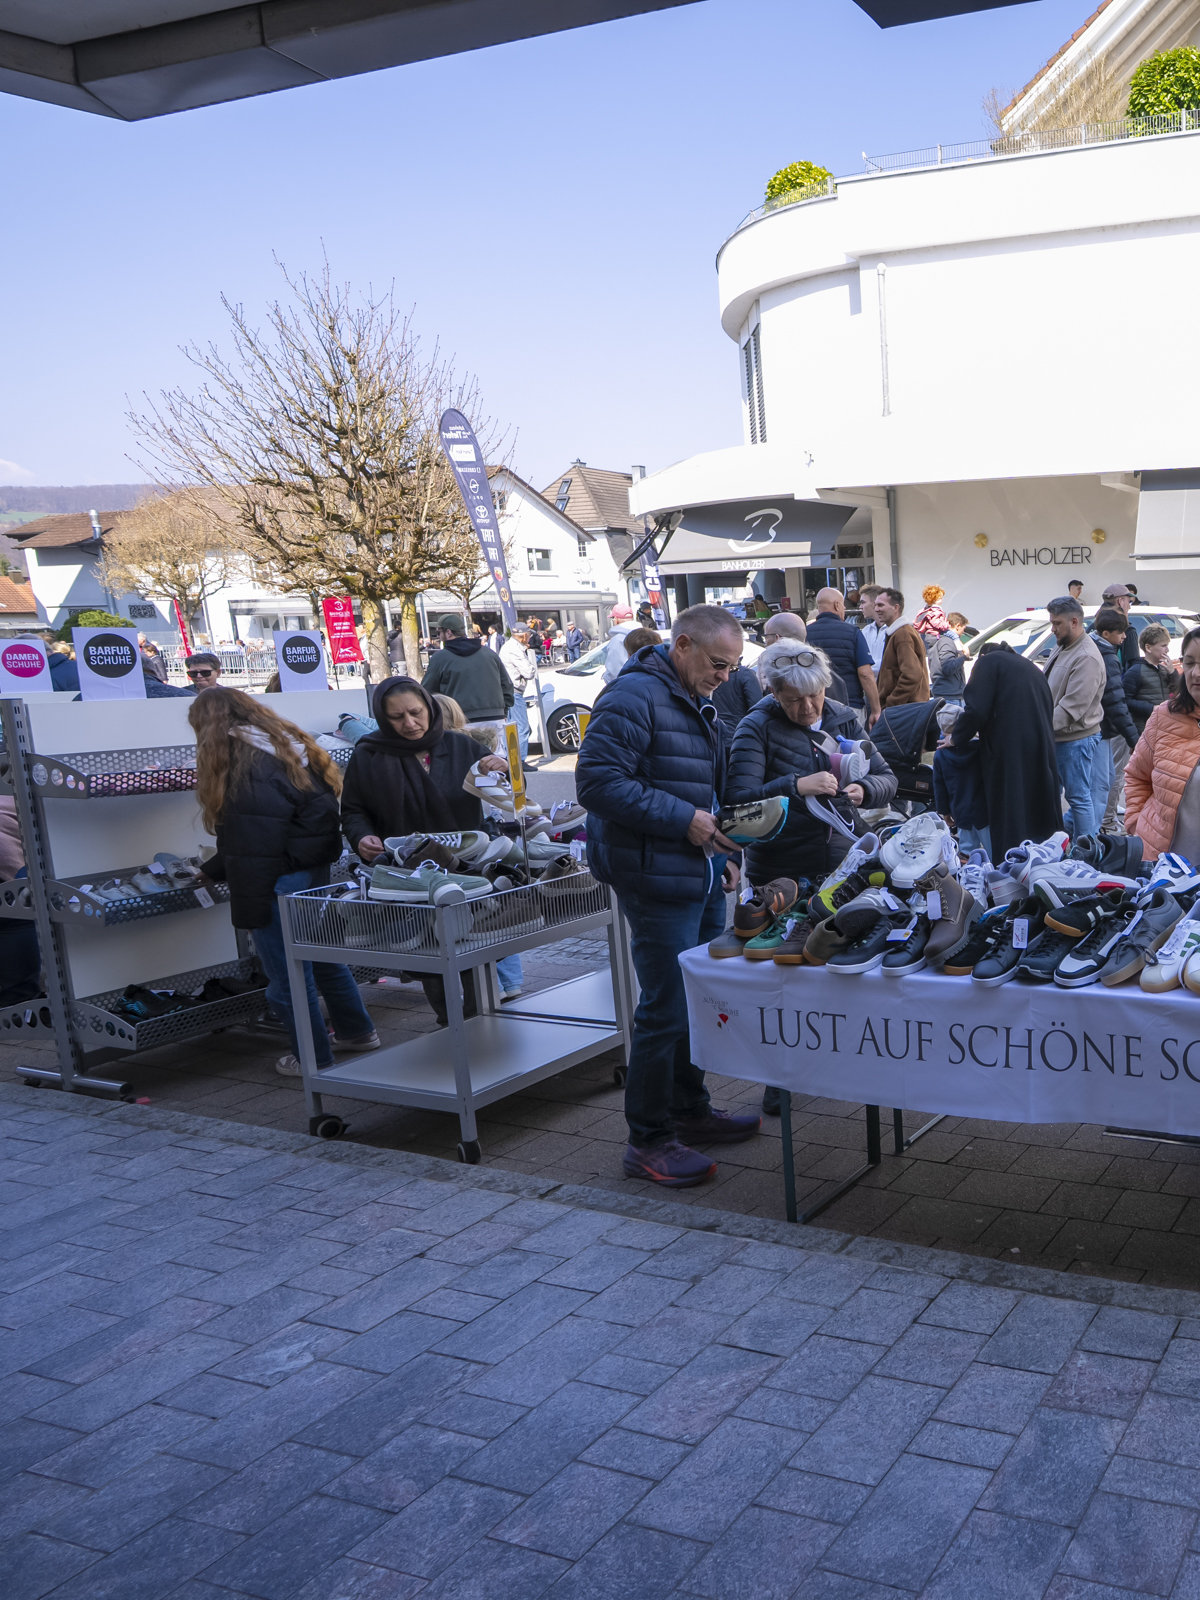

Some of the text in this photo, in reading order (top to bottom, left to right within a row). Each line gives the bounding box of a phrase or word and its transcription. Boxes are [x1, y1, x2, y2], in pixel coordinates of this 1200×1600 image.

[990, 546, 1092, 567] BANHOLZER
[722, 559, 765, 571] BANHOLZER
[88, 646, 131, 656] BARFUß
[285, 646, 316, 655] BARFUß
[5, 653, 39, 661] DAMEN
[90, 655, 133, 665] SCHUHE
[287, 654, 318, 664] SCHUHE
[6, 661, 42, 669] SCHUHE
[757, 1006, 847, 1053] LUST
[855, 1016, 934, 1061] AUF
[948, 1021, 1144, 1078] SCHÖNE
